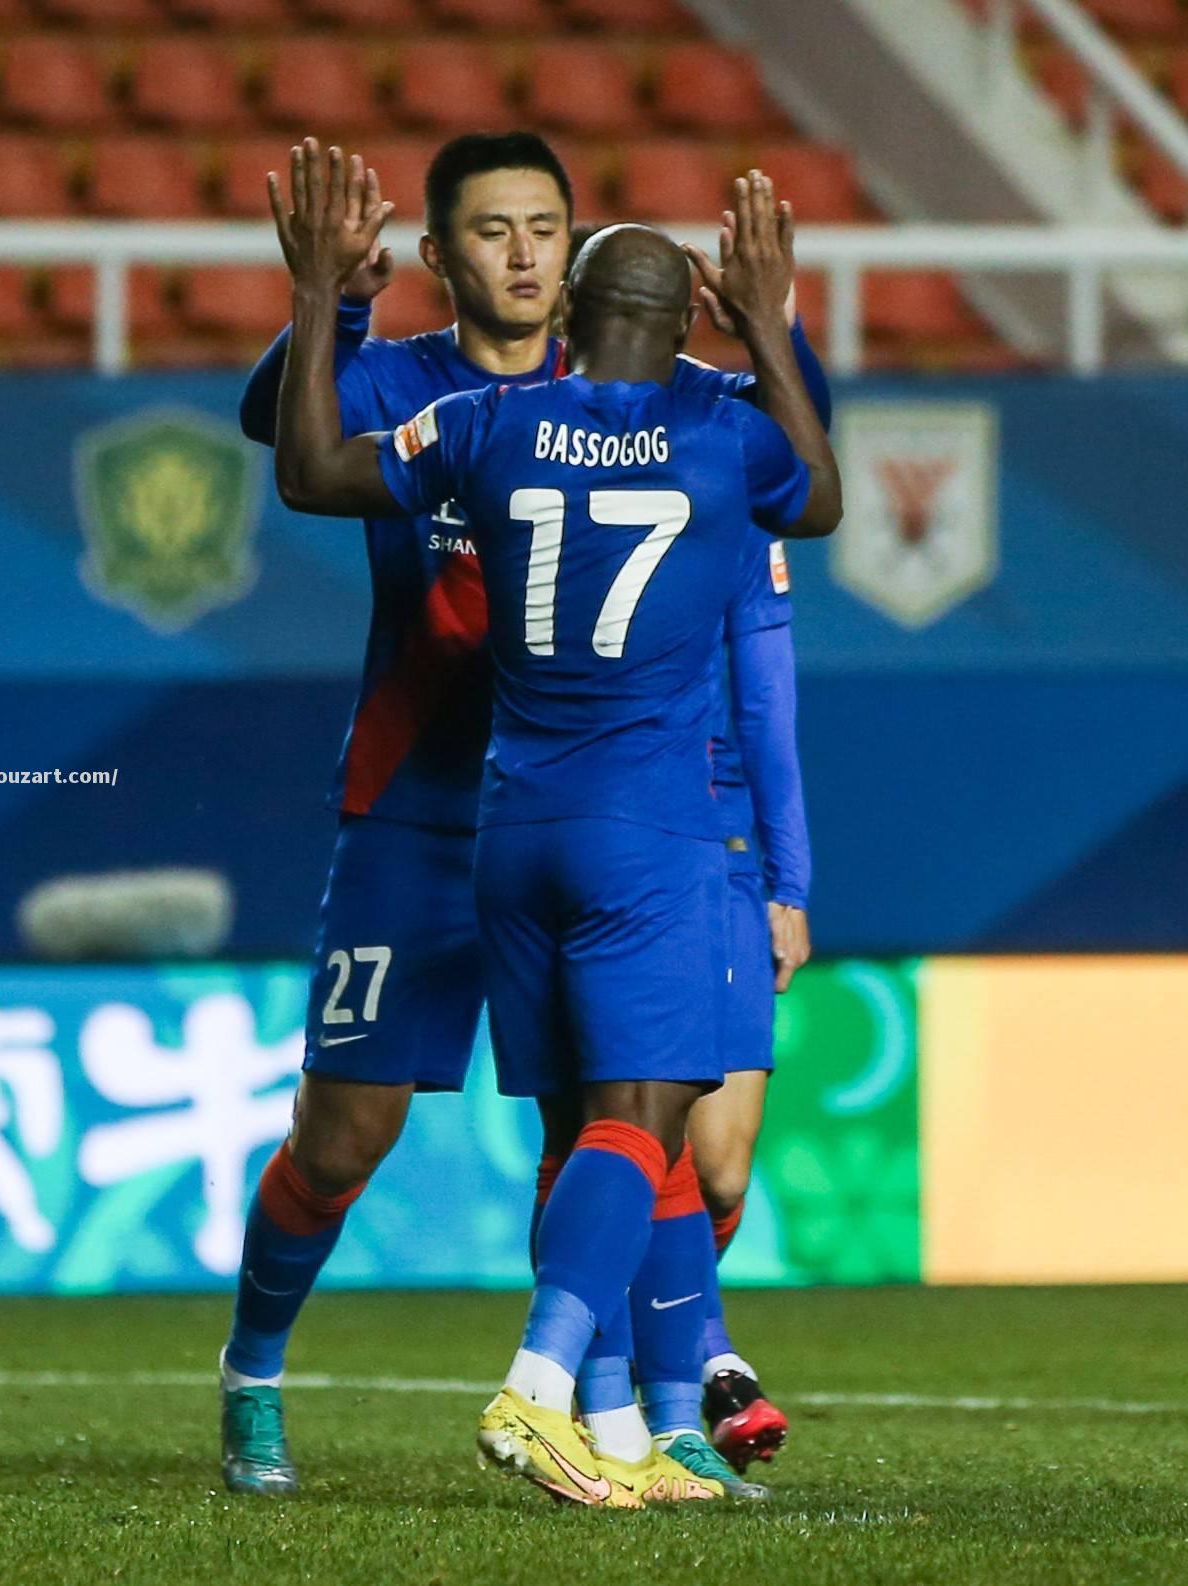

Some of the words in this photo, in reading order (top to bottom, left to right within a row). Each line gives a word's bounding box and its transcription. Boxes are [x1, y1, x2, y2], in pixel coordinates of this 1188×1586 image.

[534, 420, 670, 467] BASSOGOG
[509, 487, 691, 659] 17
[322, 946, 392, 1024] 27
